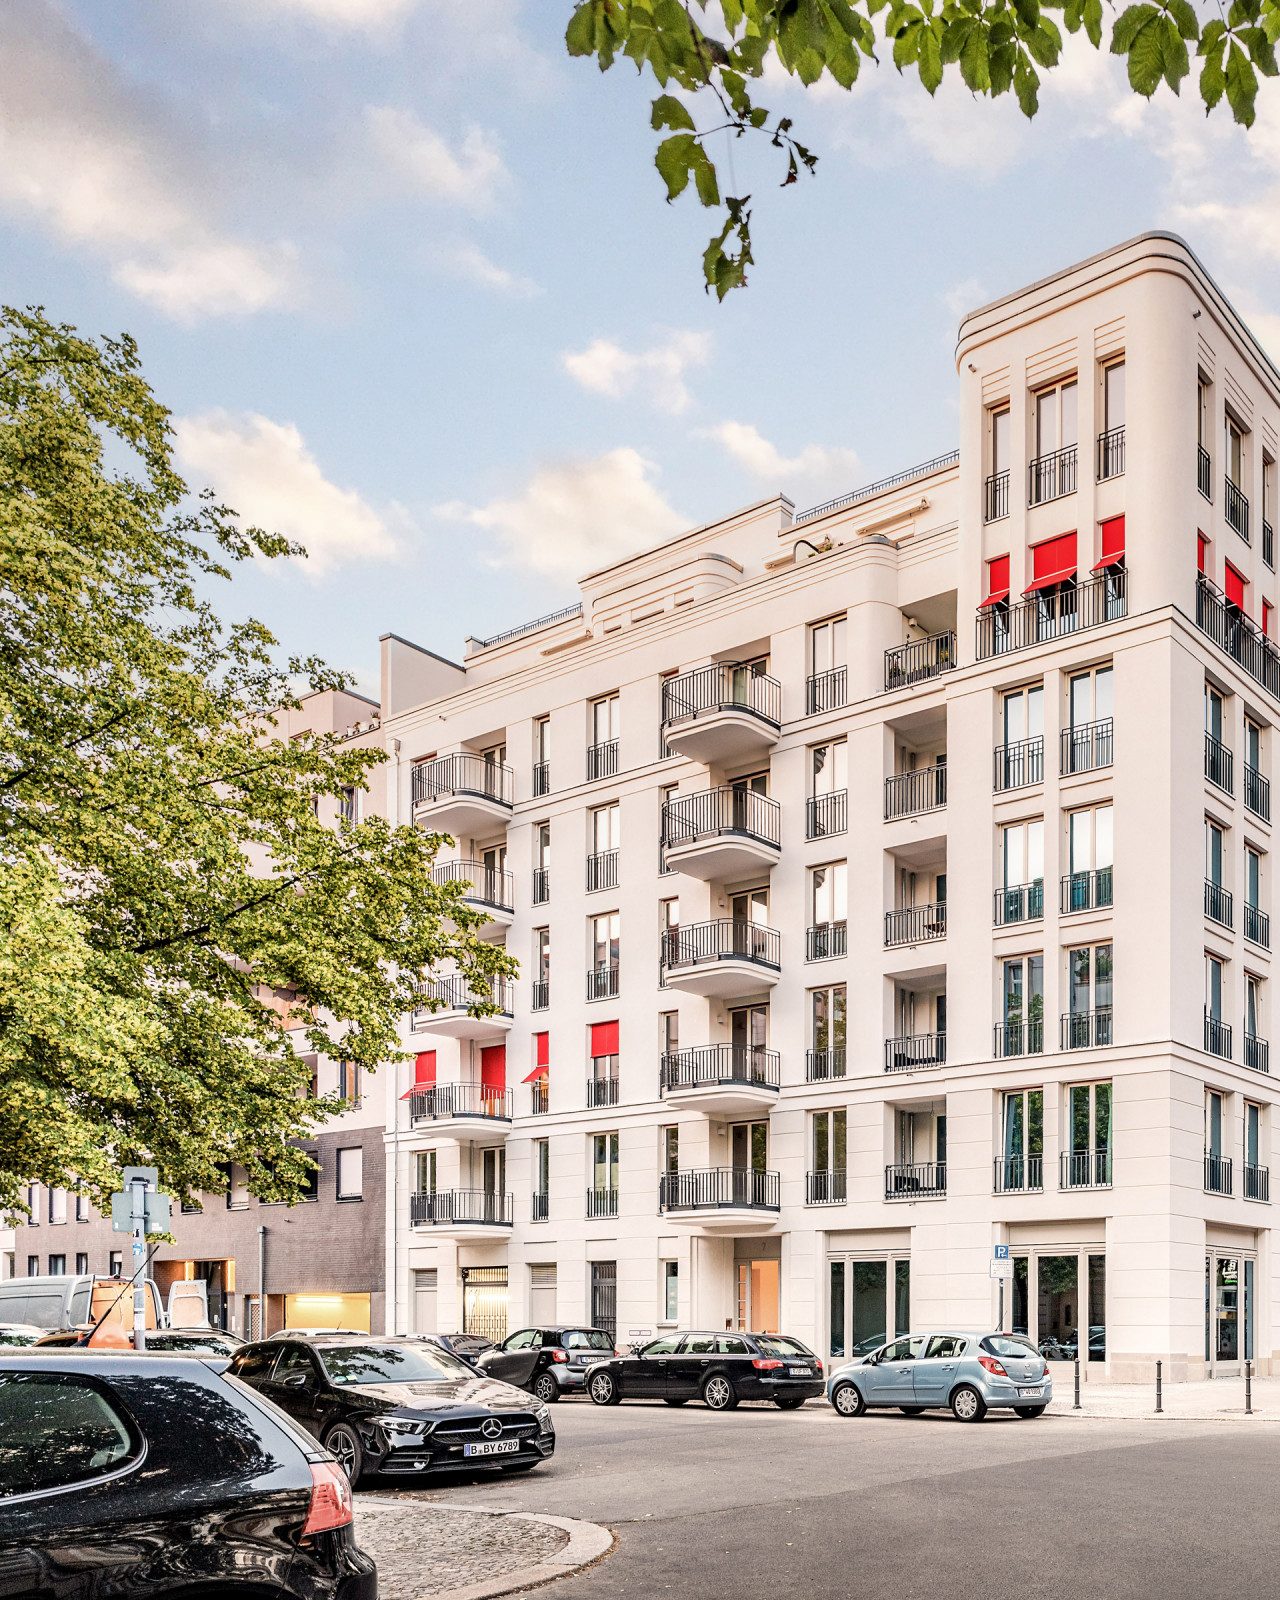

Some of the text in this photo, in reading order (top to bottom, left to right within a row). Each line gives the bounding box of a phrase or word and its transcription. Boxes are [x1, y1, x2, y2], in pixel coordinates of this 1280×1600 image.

[997, 1246, 1006, 1258] P
[471, 1441, 518, 1455] B BY 6789
